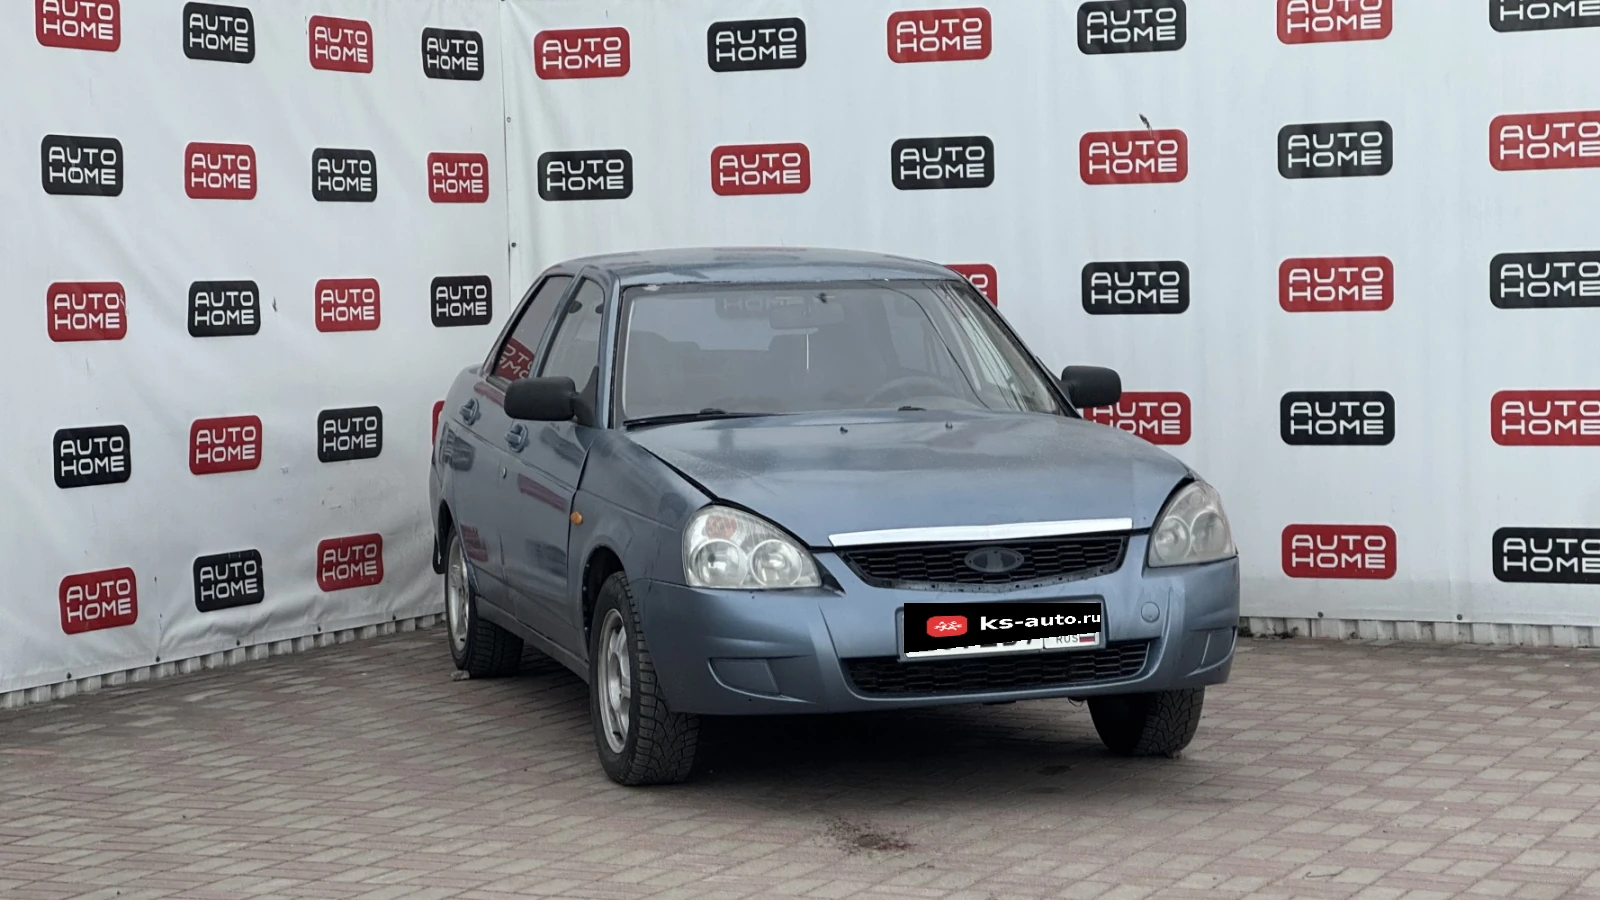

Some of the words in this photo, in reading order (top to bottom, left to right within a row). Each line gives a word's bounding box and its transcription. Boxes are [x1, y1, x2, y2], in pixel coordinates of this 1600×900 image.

[43, 0, 113, 20] AUTO
[1287, 0, 1382, 15] AUTO
[1500, 1, 1600, 21] HOME
[190, 14, 248, 33] AUTO
[1087, 8, 1176, 26] AUTO
[1288, 14, 1380, 34] HOME
[44, 18, 113, 40] HOME
[315, 26, 367, 45] AUTO
[897, 18, 982, 36] AUTO
[1087, 26, 1175, 44] HOME
[190, 32, 248, 52] HOME
[543, 37, 621, 53] AUTO
[716, 28, 797, 45] AUTO
[897, 35, 981, 53] HOME
[315, 44, 368, 63] HOME
[427, 38, 478, 54] AUTO
[716, 44, 796, 62] HOME
[427, 54, 478, 70] HOME
[543, 54, 620, 70] HOME
[1500, 122, 1600, 141] AUTO
[1089, 140, 1178, 156] AUTO
[1288, 132, 1382, 150] AUTO
[49, 147, 116, 165] AUTO
[900, 146, 985, 162] AUTO
[1288, 150, 1381, 168] HOME
[1500, 141, 1600, 160] HOME
[192, 154, 250, 170] AUTO
[318, 159, 371, 174] AUTO
[433, 162, 482, 176] AUTO
[547, 159, 624, 175] AUTO
[720, 153, 800, 169] AUTO
[1089, 158, 1177, 174] HOME
[50, 166, 116, 184] HOME
[192, 172, 250, 188] HOME
[720, 170, 800, 186] HOME
[901, 164, 984, 180] HOME
[318, 176, 371, 191] HOME
[434, 179, 483, 193] HOME
[547, 176, 624, 191] HOME
[1091, 271, 1180, 286] AUTO
[1289, 267, 1383, 284] AUTO
[1501, 262, 1600, 279] AUTO
[321, 289, 374, 304] AUTO
[436, 285, 486, 300] AUTO
[1092, 289, 1178, 304] HOME
[1289, 285, 1382, 301] HOME
[1501, 280, 1600, 298] HOME
[54, 293, 120, 310] AUTO
[195, 291, 253, 307] AUTO
[195, 310, 254, 326] HOME
[321, 306, 374, 321] HOME
[436, 302, 486, 317] HOME
[55, 313, 120, 330] HOME
[1093, 402, 1181, 417] AUTO
[1290, 402, 1384, 416] AUTO
[1502, 401, 1600, 416] AUTO
[324, 416, 377, 434] AUTO
[1291, 420, 1383, 434] HOME
[1502, 420, 1600, 434] HOME
[196, 426, 256, 445] AUTO
[324, 434, 376, 452] HOME
[61, 436, 123, 456] AUTO
[196, 444, 255, 464] HOME
[61, 456, 124, 476] HOME
[1292, 535, 1386, 550] AUTO
[1504, 538, 1600, 554] AUTO
[323, 544, 376, 564] AUTO
[1292, 552, 1385, 568] HOME
[200, 560, 256, 582] AUTO
[322, 560, 377, 582] HOME
[1504, 556, 1600, 573] HOME
[67, 579, 130, 603] AUTO
[201, 578, 258, 601] HOME
[67, 598, 131, 622] HOME
